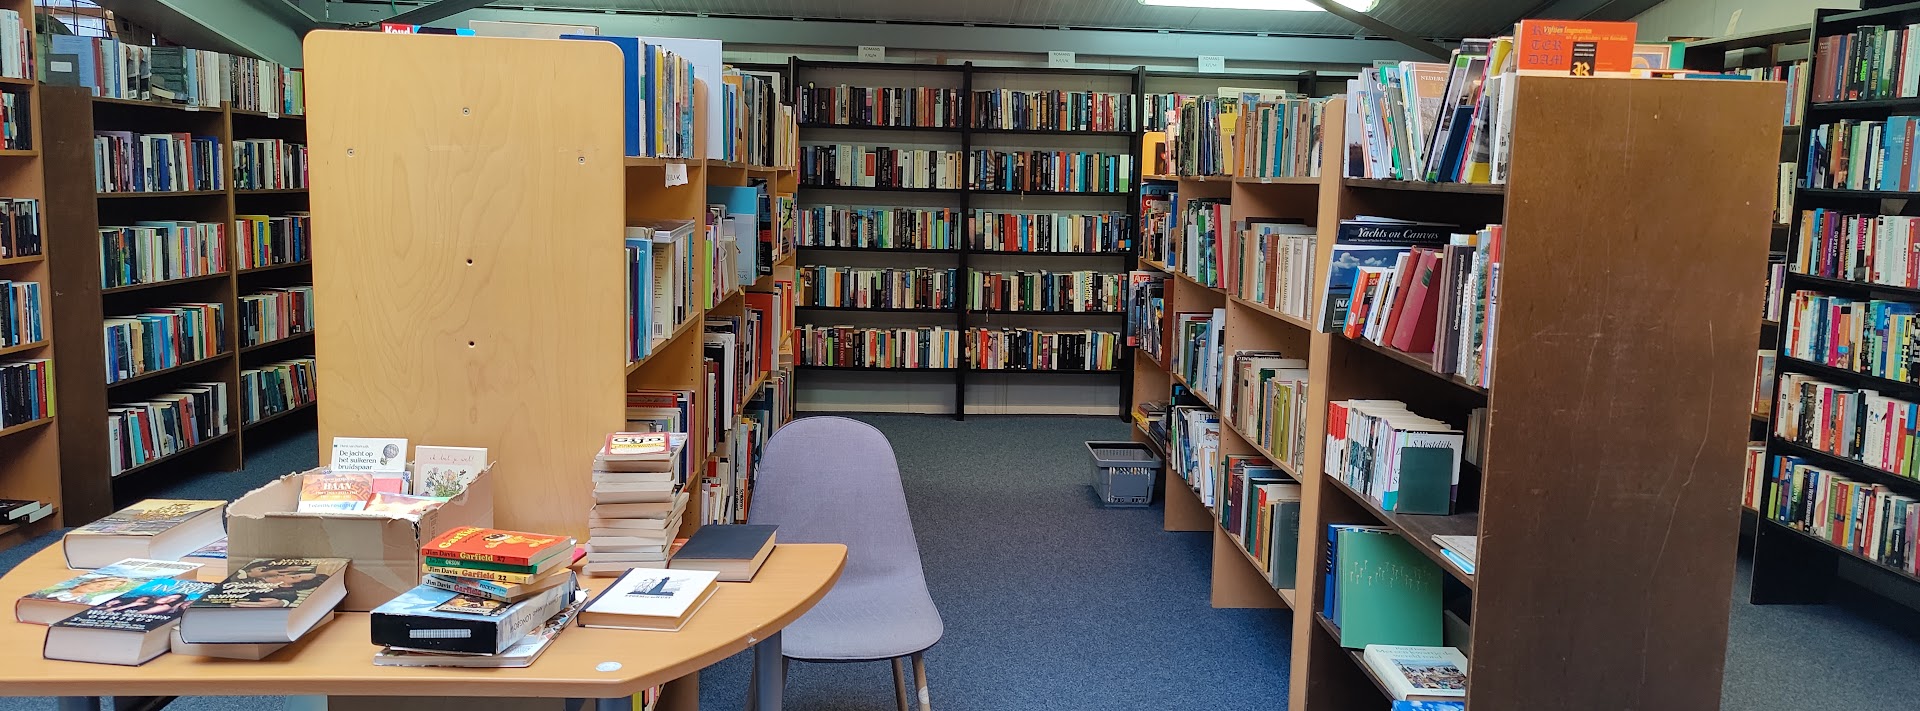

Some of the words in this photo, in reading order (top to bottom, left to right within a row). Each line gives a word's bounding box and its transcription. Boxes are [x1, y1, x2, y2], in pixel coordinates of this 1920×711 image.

[1358, 228, 1387, 238] Yachts
[1403, 229, 1439, 239] Canvas
[460, 552, 494, 562] Garfield
[462, 570, 495, 579] Garfield
[454, 584, 481, 596] Garfield
